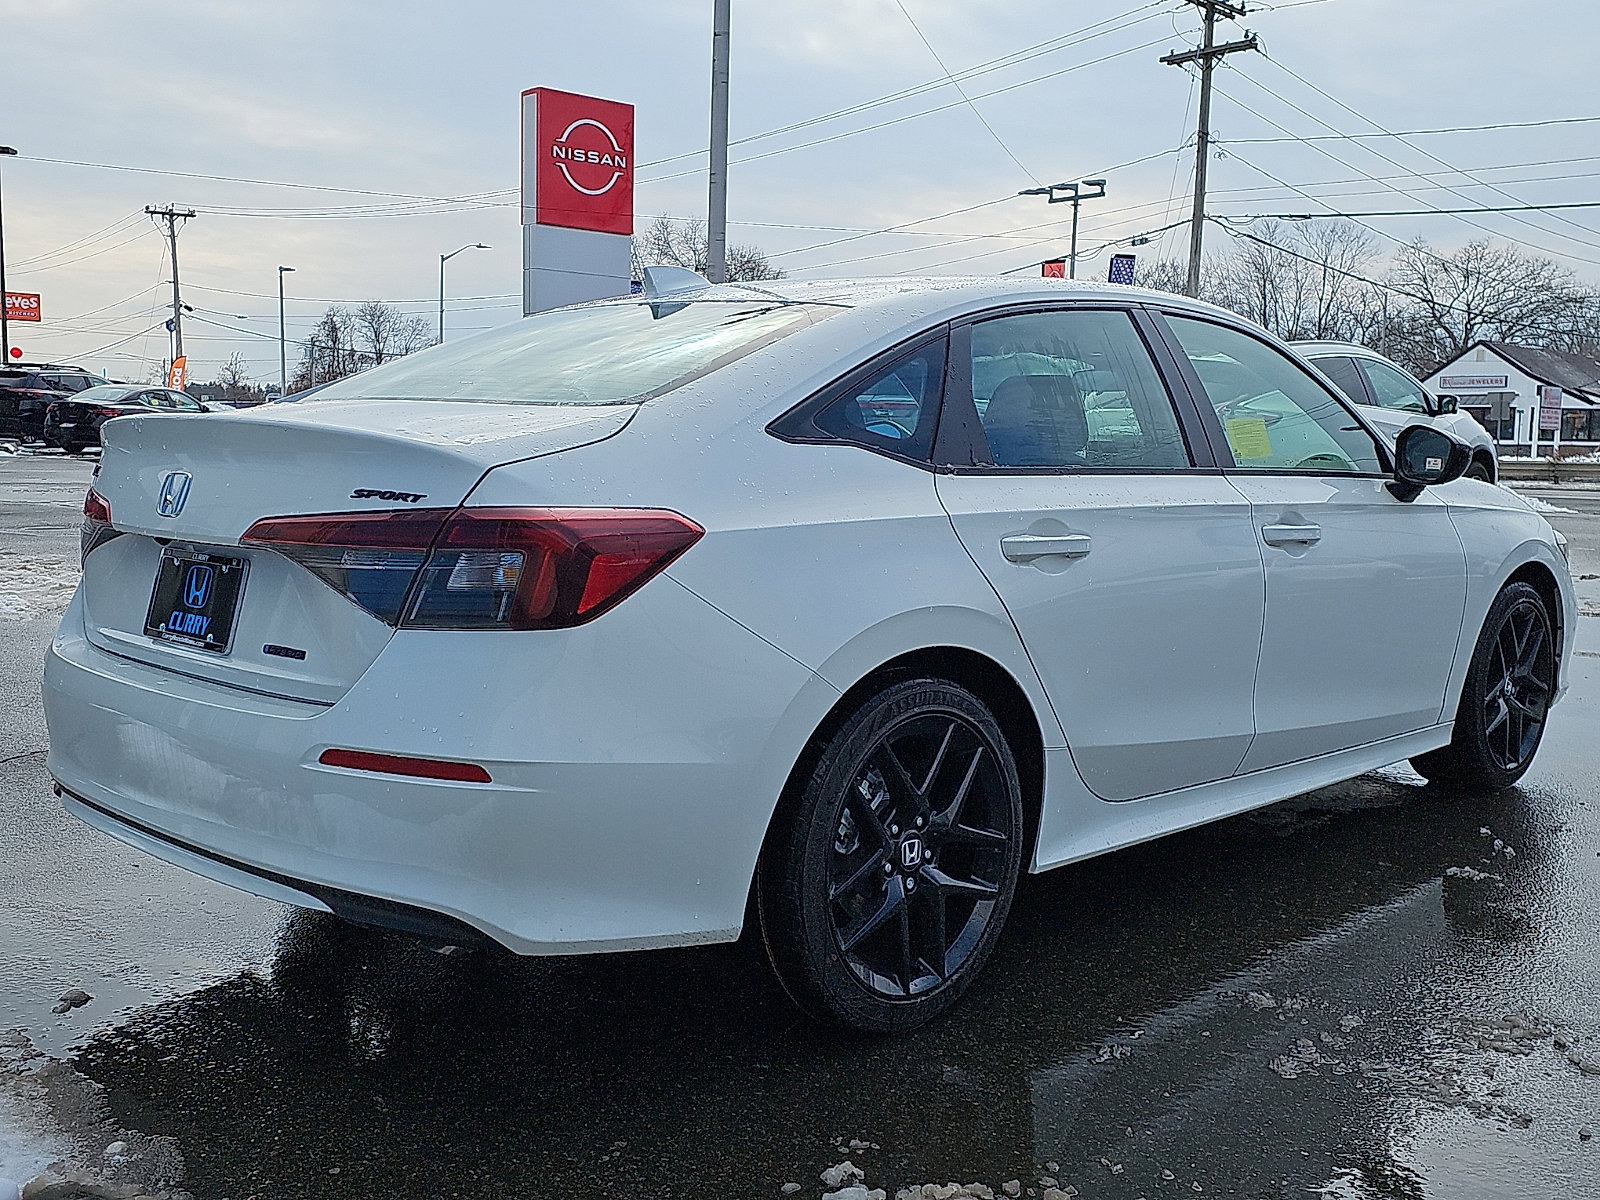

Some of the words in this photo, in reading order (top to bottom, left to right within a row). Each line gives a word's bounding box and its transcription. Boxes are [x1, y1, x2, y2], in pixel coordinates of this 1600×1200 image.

[552, 145, 627, 169] NISSAN
[349, 488, 428, 503] SPORT
[168, 610, 212, 636] CURRY
